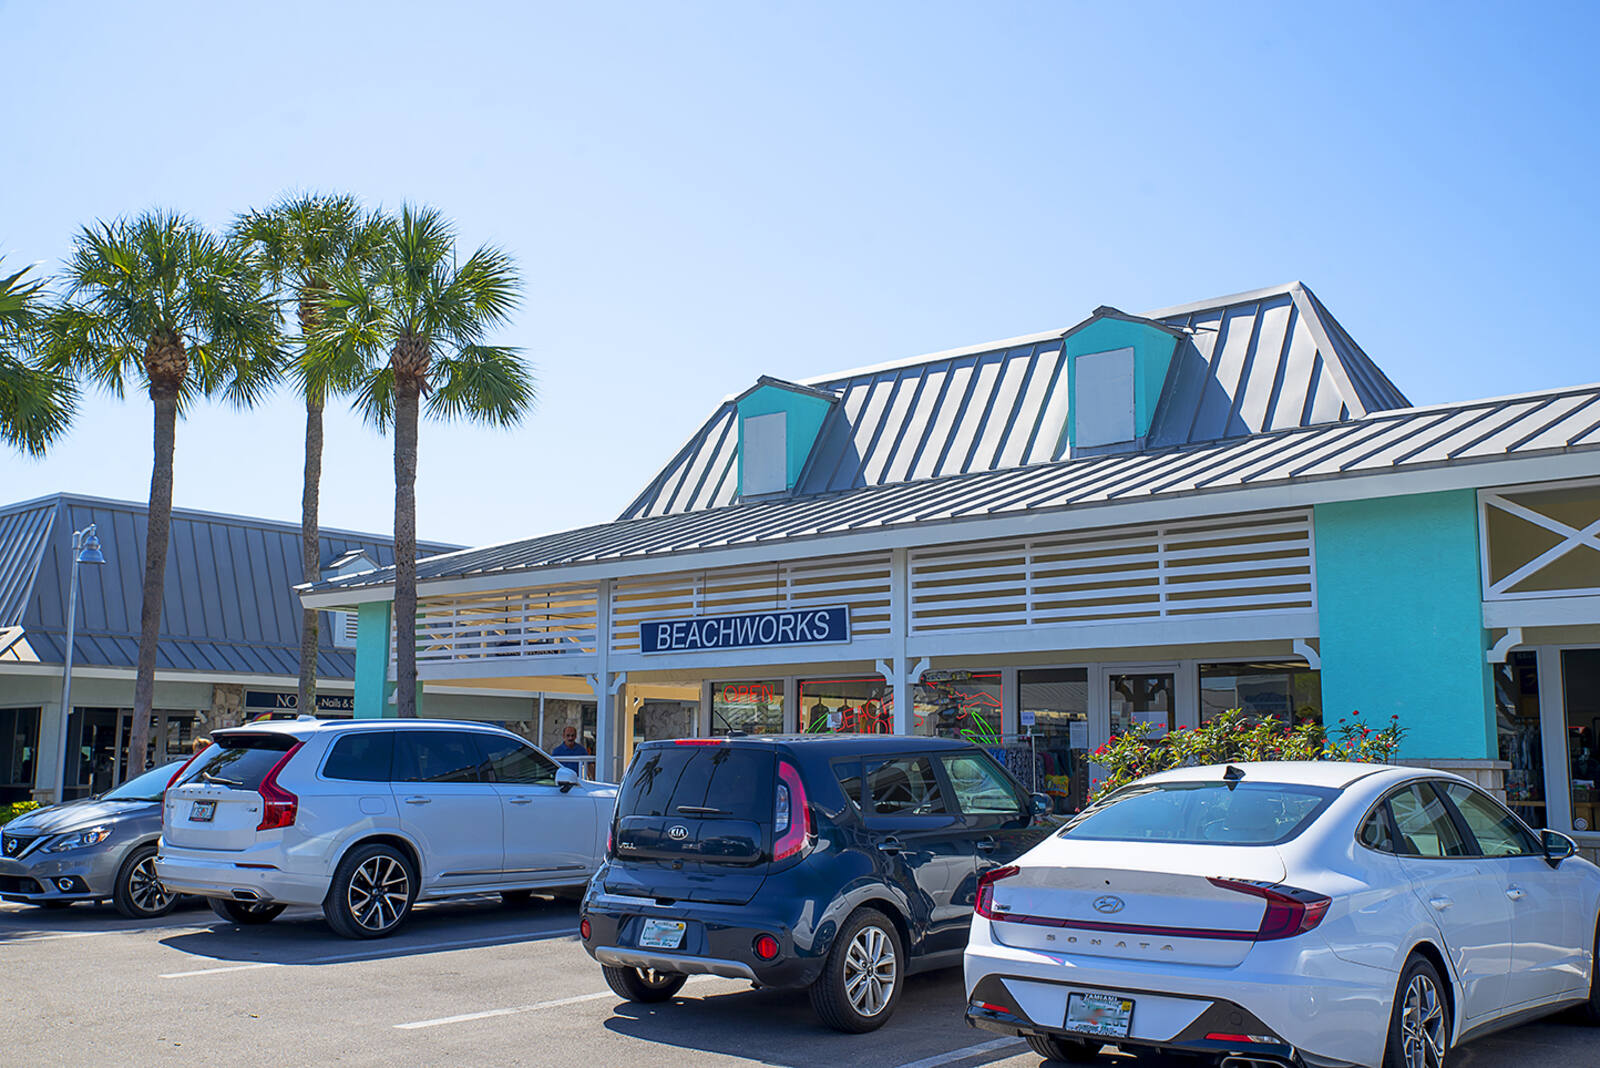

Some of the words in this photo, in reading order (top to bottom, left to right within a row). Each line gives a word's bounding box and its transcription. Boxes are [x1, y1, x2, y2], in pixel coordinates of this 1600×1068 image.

[656, 611, 830, 650] BEACHWORKS
[276, 694, 299, 708] NO
[321, 698, 341, 708] Nails
[723, 684, 774, 703] OPEN
[671, 828, 685, 837] KIA
[1045, 933, 1176, 952] SONATA
